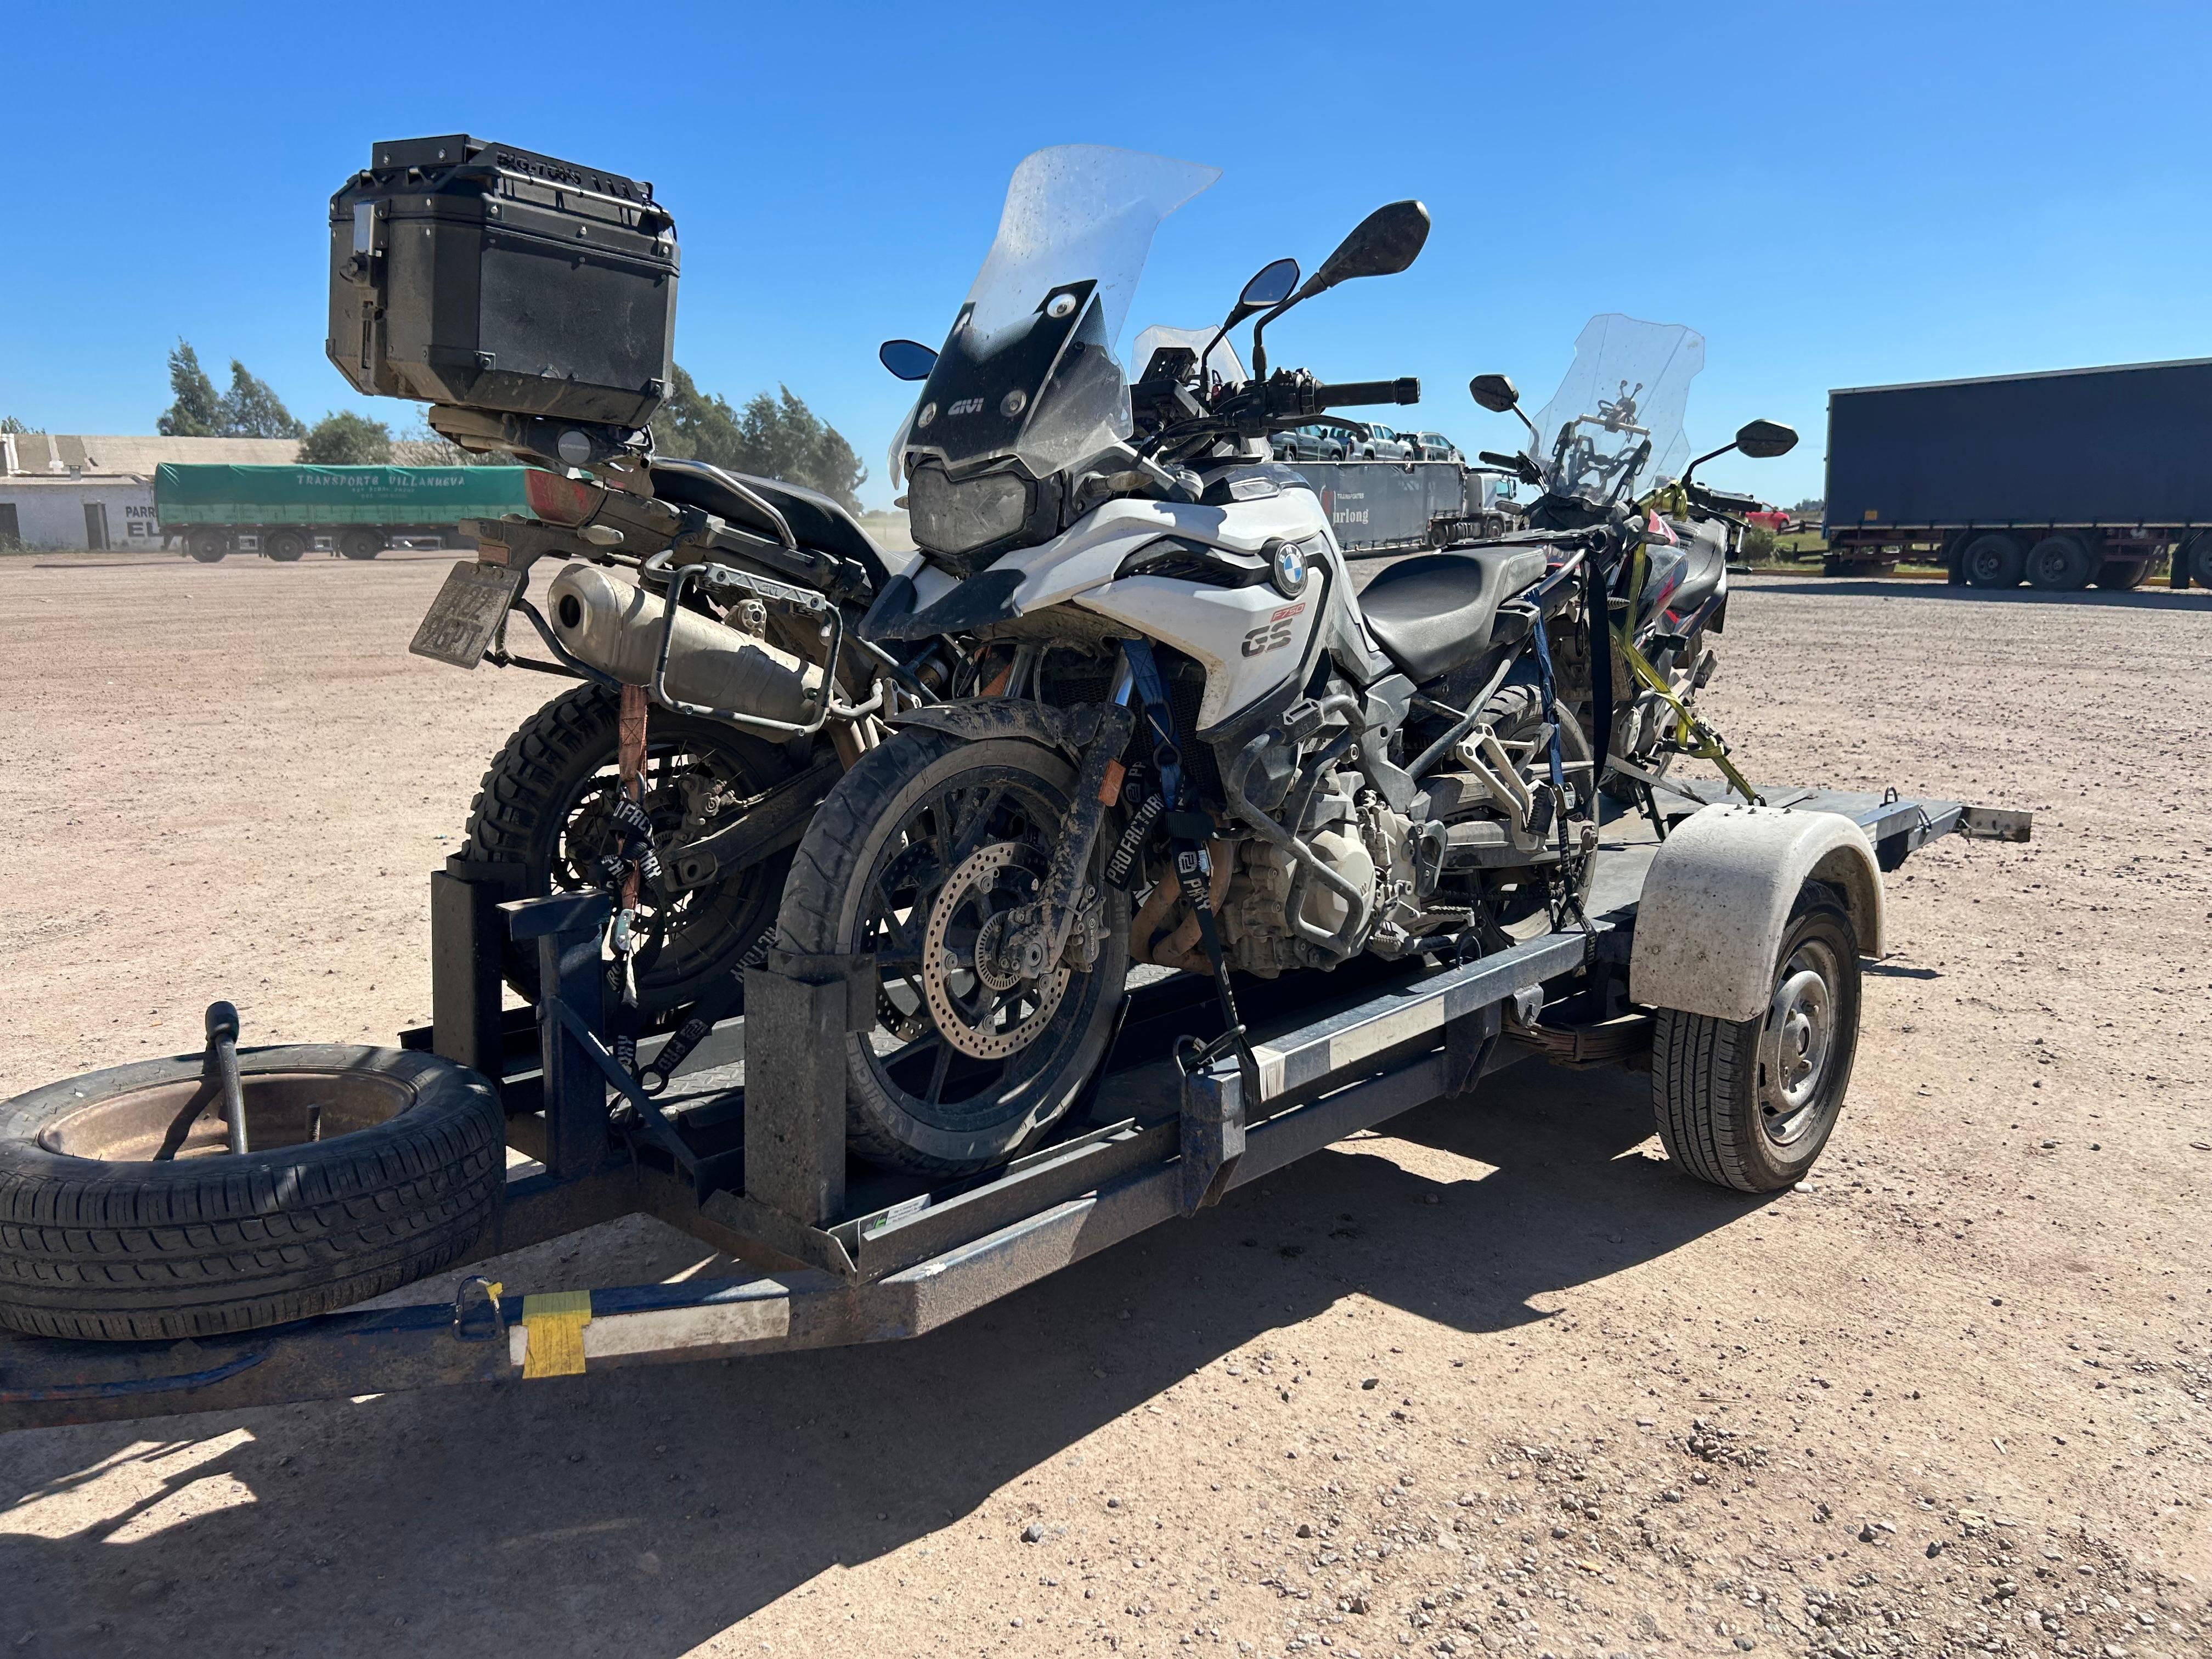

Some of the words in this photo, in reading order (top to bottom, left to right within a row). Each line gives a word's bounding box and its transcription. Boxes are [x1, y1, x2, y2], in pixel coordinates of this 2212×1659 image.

[947, 398, 984, 415] GIVI
[389, 475, 465, 487] VILLANUEVA
[126, 506, 155, 518] PARR
[1279, 546, 1302, 563] BMW
[1272, 604, 1305, 620] F750
[1242, 618, 1293, 657] GS
